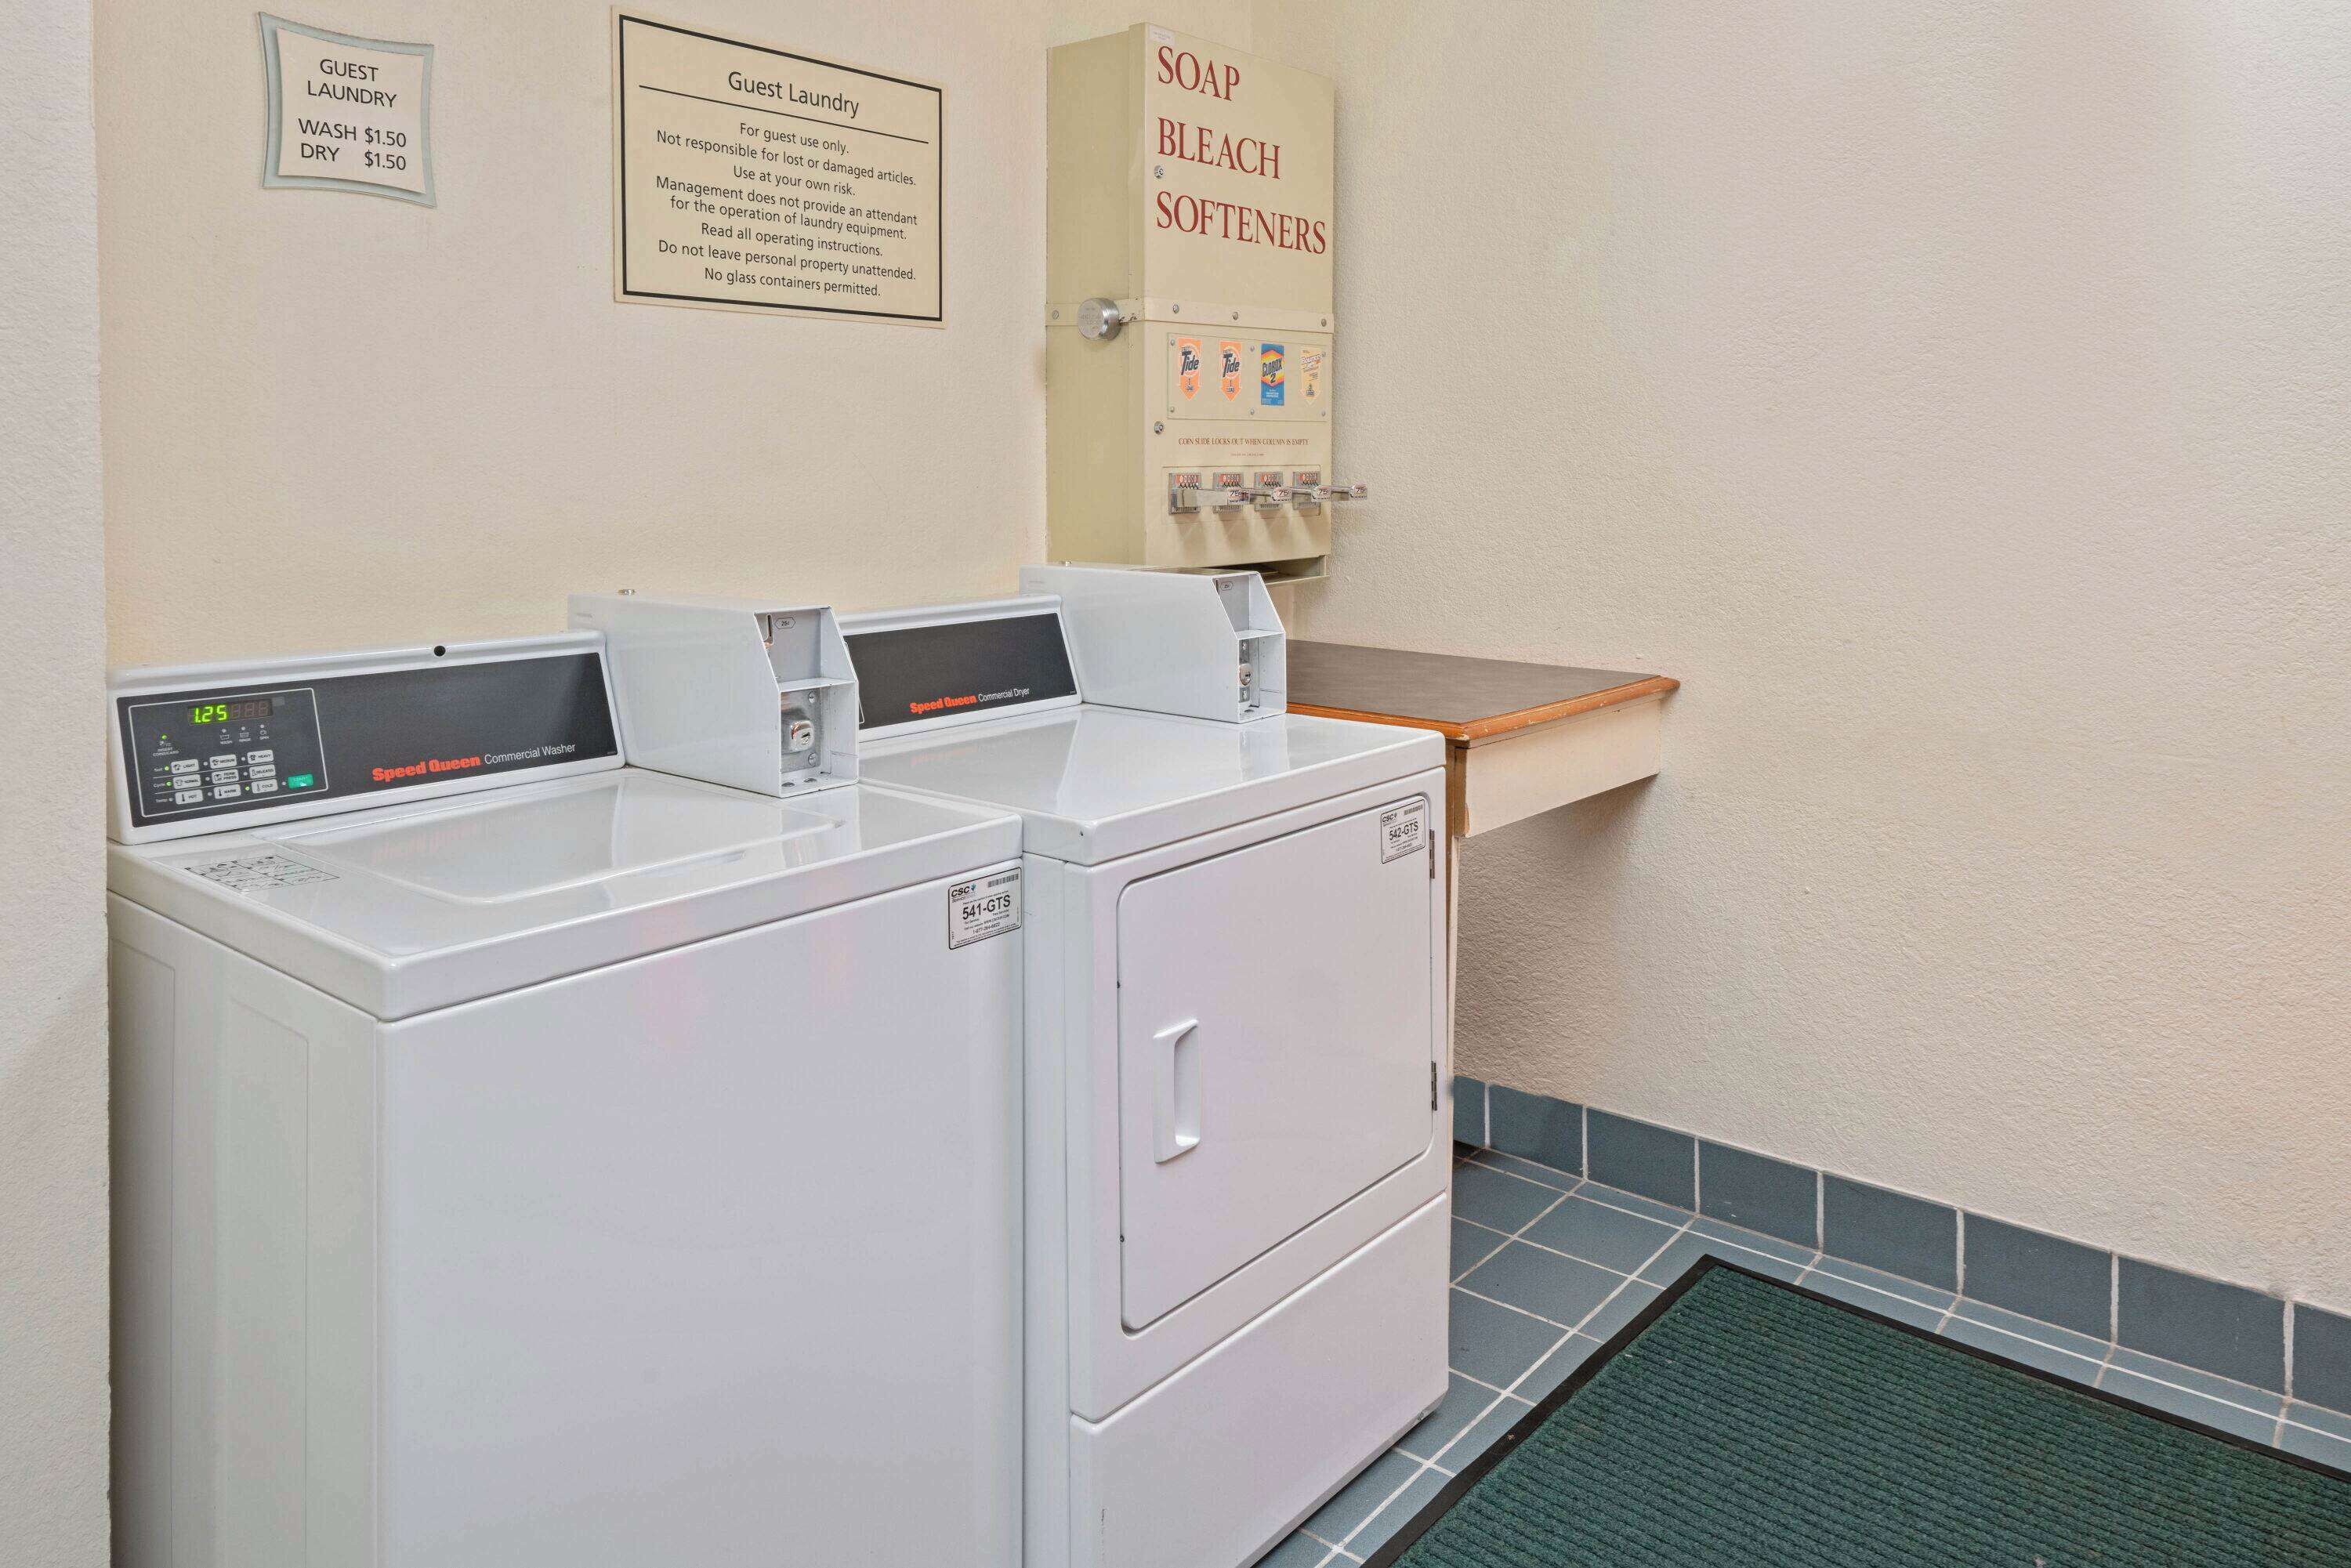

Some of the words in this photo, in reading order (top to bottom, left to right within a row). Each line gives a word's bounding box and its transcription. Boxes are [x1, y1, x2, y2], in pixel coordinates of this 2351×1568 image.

[320, 59, 379, 81] GUEST
[1157, 45, 1241, 102] SOAP
[307, 81, 397, 107] LAUNDRY
[728, 71, 783, 99] Guest
[789, 83, 859, 118] Laundry
[299, 118, 357, 140] WASH
[364, 126, 407, 147] $1.50
[740, 122, 760, 137] For
[763, 129, 796, 144] guest
[800, 136, 819, 148] use
[823, 139, 849, 155] only.
[301, 143, 340, 162] DRY
[364, 150, 407, 170] $1.50
[657, 130, 682, 147] Not
[686, 137, 757, 158] responsible
[761, 147, 780, 162] for
[784, 151, 804, 167] lost
[807, 159, 820, 168] or
[823, 159, 874, 179] damaged
[877, 170, 916, 186] articles.
[1157, 117, 1281, 180] BLEACH
[734, 165, 755, 180] Use
[759, 171, 772, 183] at
[775, 174, 802, 186] your
[806, 179, 830, 192] own
[834, 182, 856, 196] risk.
[657, 176, 744, 200] Management
[747, 189, 776, 205] does
[779, 196, 800, 208] not
[803, 200, 846, 215] provide
[849, 207, 862, 217] an
[866, 209, 918, 225] attendant
[670, 195, 690, 210] for
[694, 199, 715, 214] the
[719, 205, 781, 223] operation
[784, 212, 797, 225] of
[800, 213, 843, 234] laundry
[846, 223, 907, 240] equipment.
[1156, 190, 1326, 255] SOFTENERS
[701, 223, 734, 238] Read
[737, 227, 752, 241] all
[755, 232, 813, 251] operating
[817, 237, 883, 256] instructions.
[658, 240, 677, 254] Do
[682, 244, 705, 257] not
[708, 244, 741, 261] leave
[745, 252, 796, 267] personal
[800, 258, 849, 275] property
[852, 264, 916, 280] unattended.
[705, 267, 723, 281] No
[726, 270, 756, 285] glass
[759, 276, 820, 291] containers
[824, 282, 881, 296] permitted.
[1180, 350, 1200, 376] Tide
[1223, 353, 1240, 378] Tide
[1262, 357, 1283, 378] CLOROX
[1270, 373, 1277, 384] 2
[910, 697, 944, 715] Speed
[944, 694, 977, 709] Queen
[978, 689, 1013, 702] Commercial
[1013, 687, 1030, 697] Dryer
[371, 763, 427, 783] Speed
[428, 755, 481, 773] Queen
[484, 747, 540, 765] Commercial
[542, 743, 576, 757] Washer
[1382, 813, 1394, 823] CSC
[1389, 820, 1418, 841] 542-GTS
[951, 885, 970, 898] CSC
[962, 894, 1011, 920] 541-GTS
